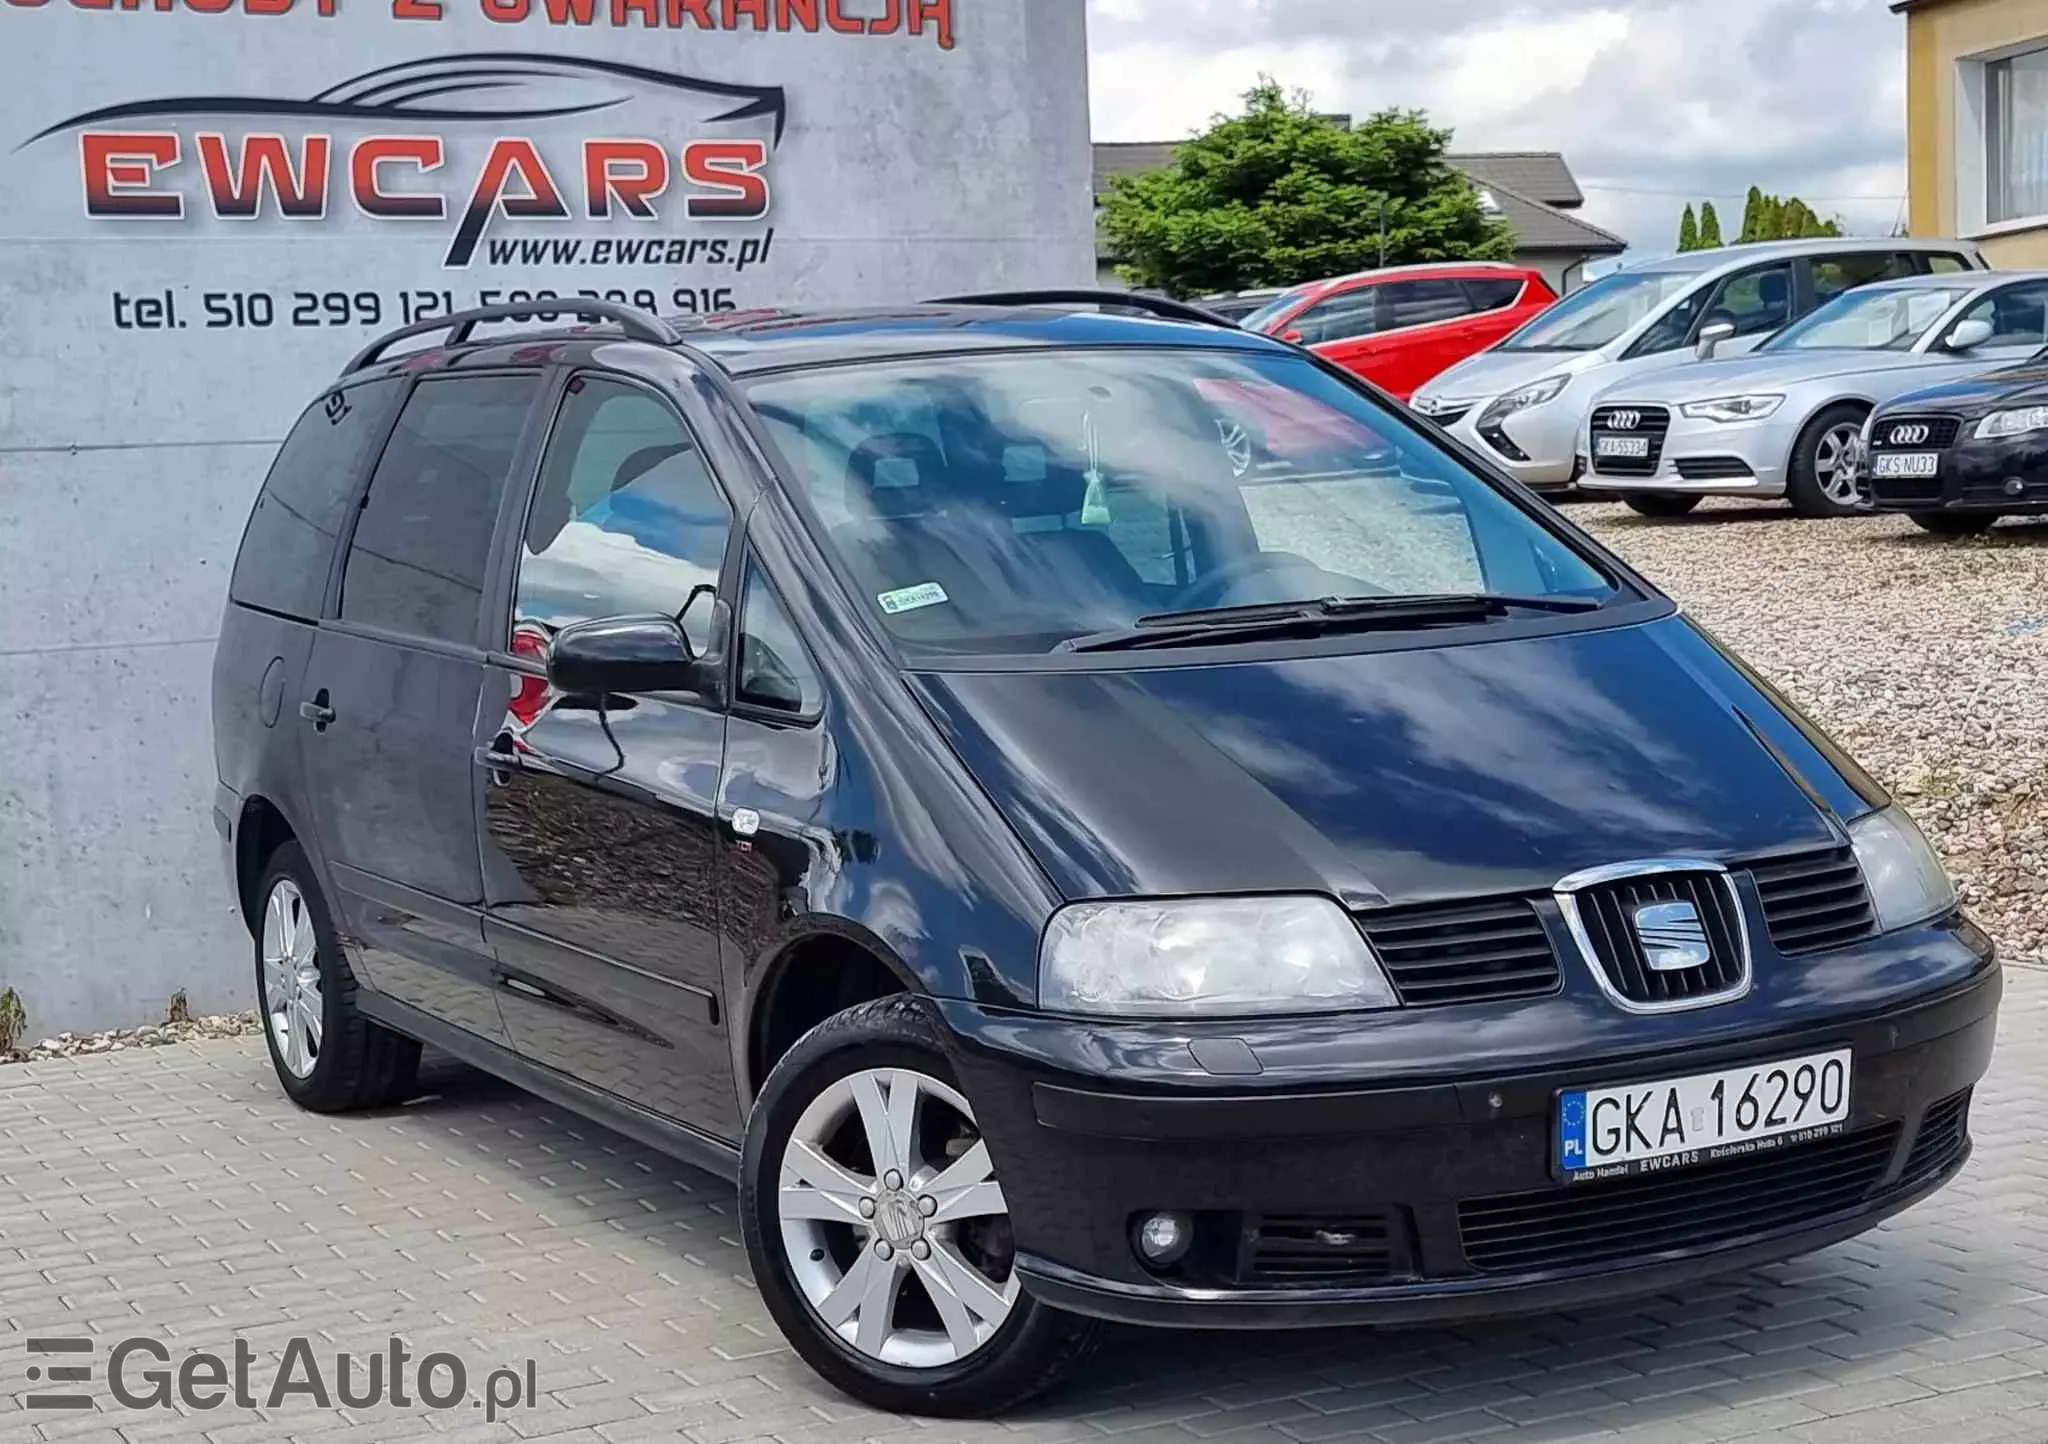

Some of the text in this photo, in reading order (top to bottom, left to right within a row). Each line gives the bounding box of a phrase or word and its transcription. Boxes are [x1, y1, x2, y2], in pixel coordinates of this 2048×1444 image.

[79, 132, 771, 270] EWCARS
[488, 228, 774, 271] www.ewcars.pl
[112, 289, 187, 329] tel.
[203, 292, 274, 328] 510
[292, 291, 381, 326] 299
[399, 290, 453, 325] 121
[1592, 1058, 1844, 1156] GKA 16290
[1564, 1138, 1583, 1157] PL
[1640, 1150, 1699, 1173] EWCARS
